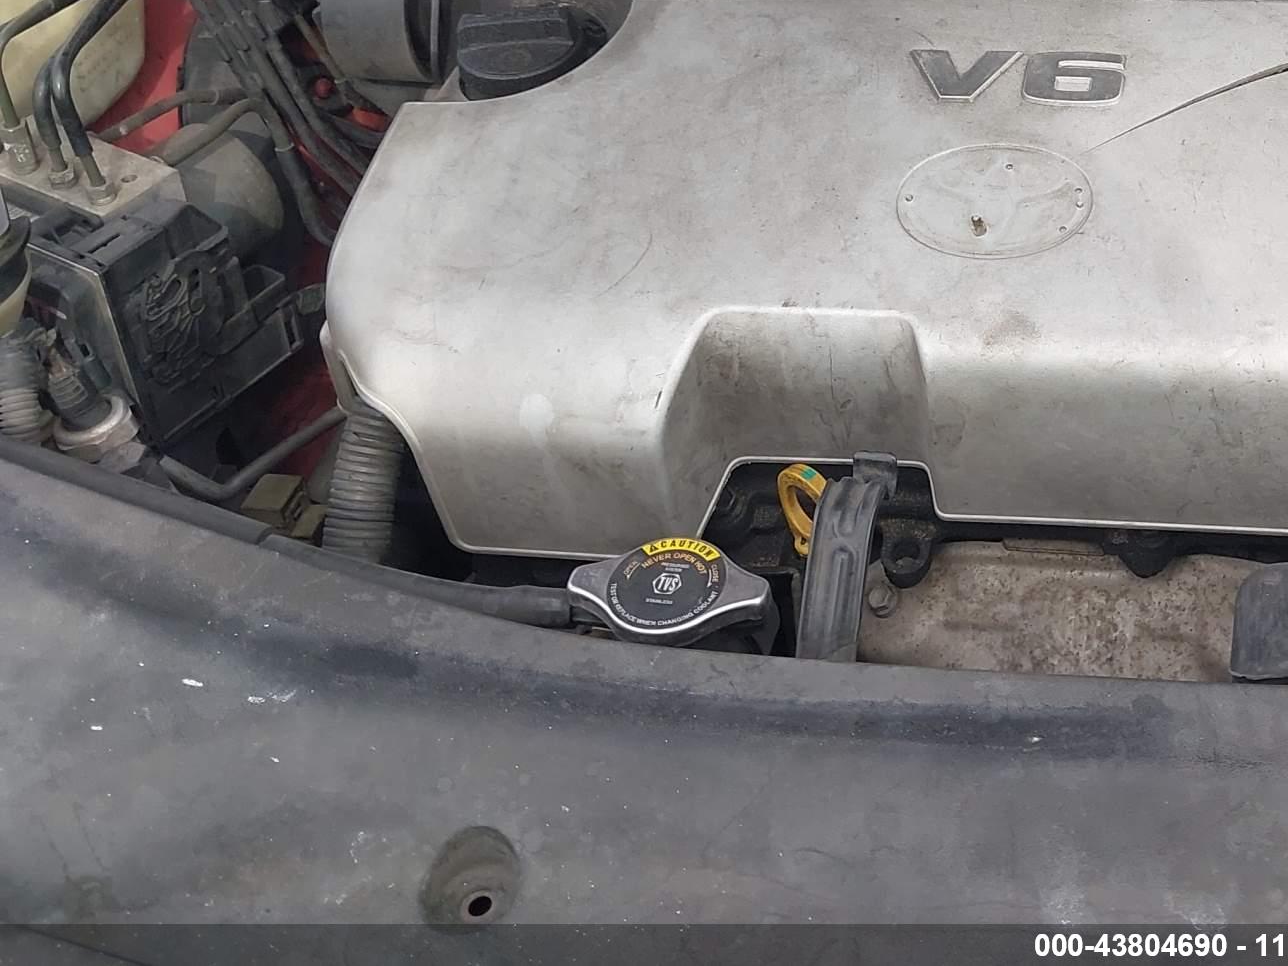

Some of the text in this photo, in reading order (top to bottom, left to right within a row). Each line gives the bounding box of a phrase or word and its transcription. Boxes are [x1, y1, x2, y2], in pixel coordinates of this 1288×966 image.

[910, 49, 1128, 107] V6
[660, 539, 715, 557] CAUTION
[623, 560, 639, 576] OPEN
[641, 552, 672, 569] NEVER
[673, 552, 698, 564] OPEN
[694, 560, 708, 575] HOT
[710, 563, 720, 583] CLOSE
[656, 575, 679, 592] TVS
[609, 582, 618, 596] TEST
[616, 603, 637, 622] REPLACE
